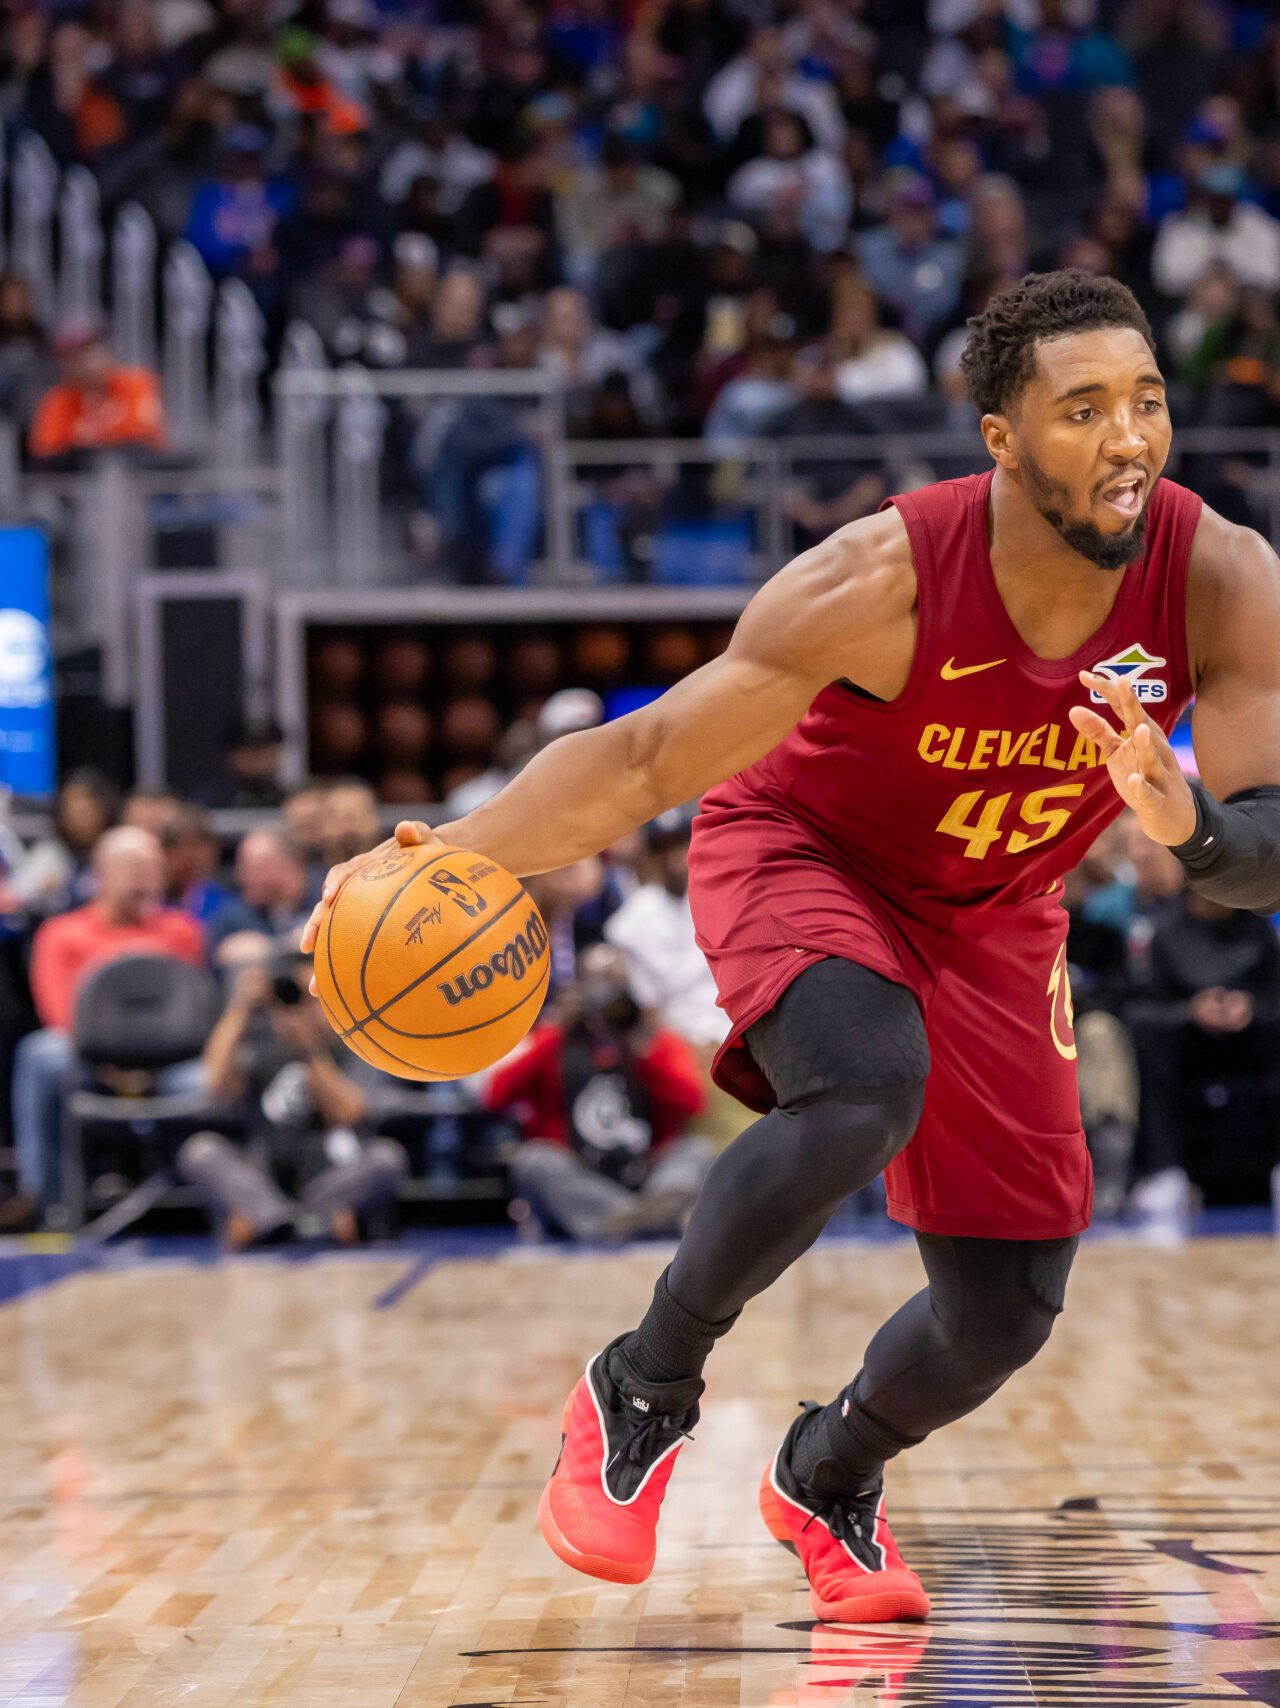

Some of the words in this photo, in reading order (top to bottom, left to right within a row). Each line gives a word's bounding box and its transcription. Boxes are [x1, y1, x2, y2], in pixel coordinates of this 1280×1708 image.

[918, 723, 1131, 771] CLEVELA
[935, 783, 1085, 860] 45
[437, 909, 548, 1006] Wilson
